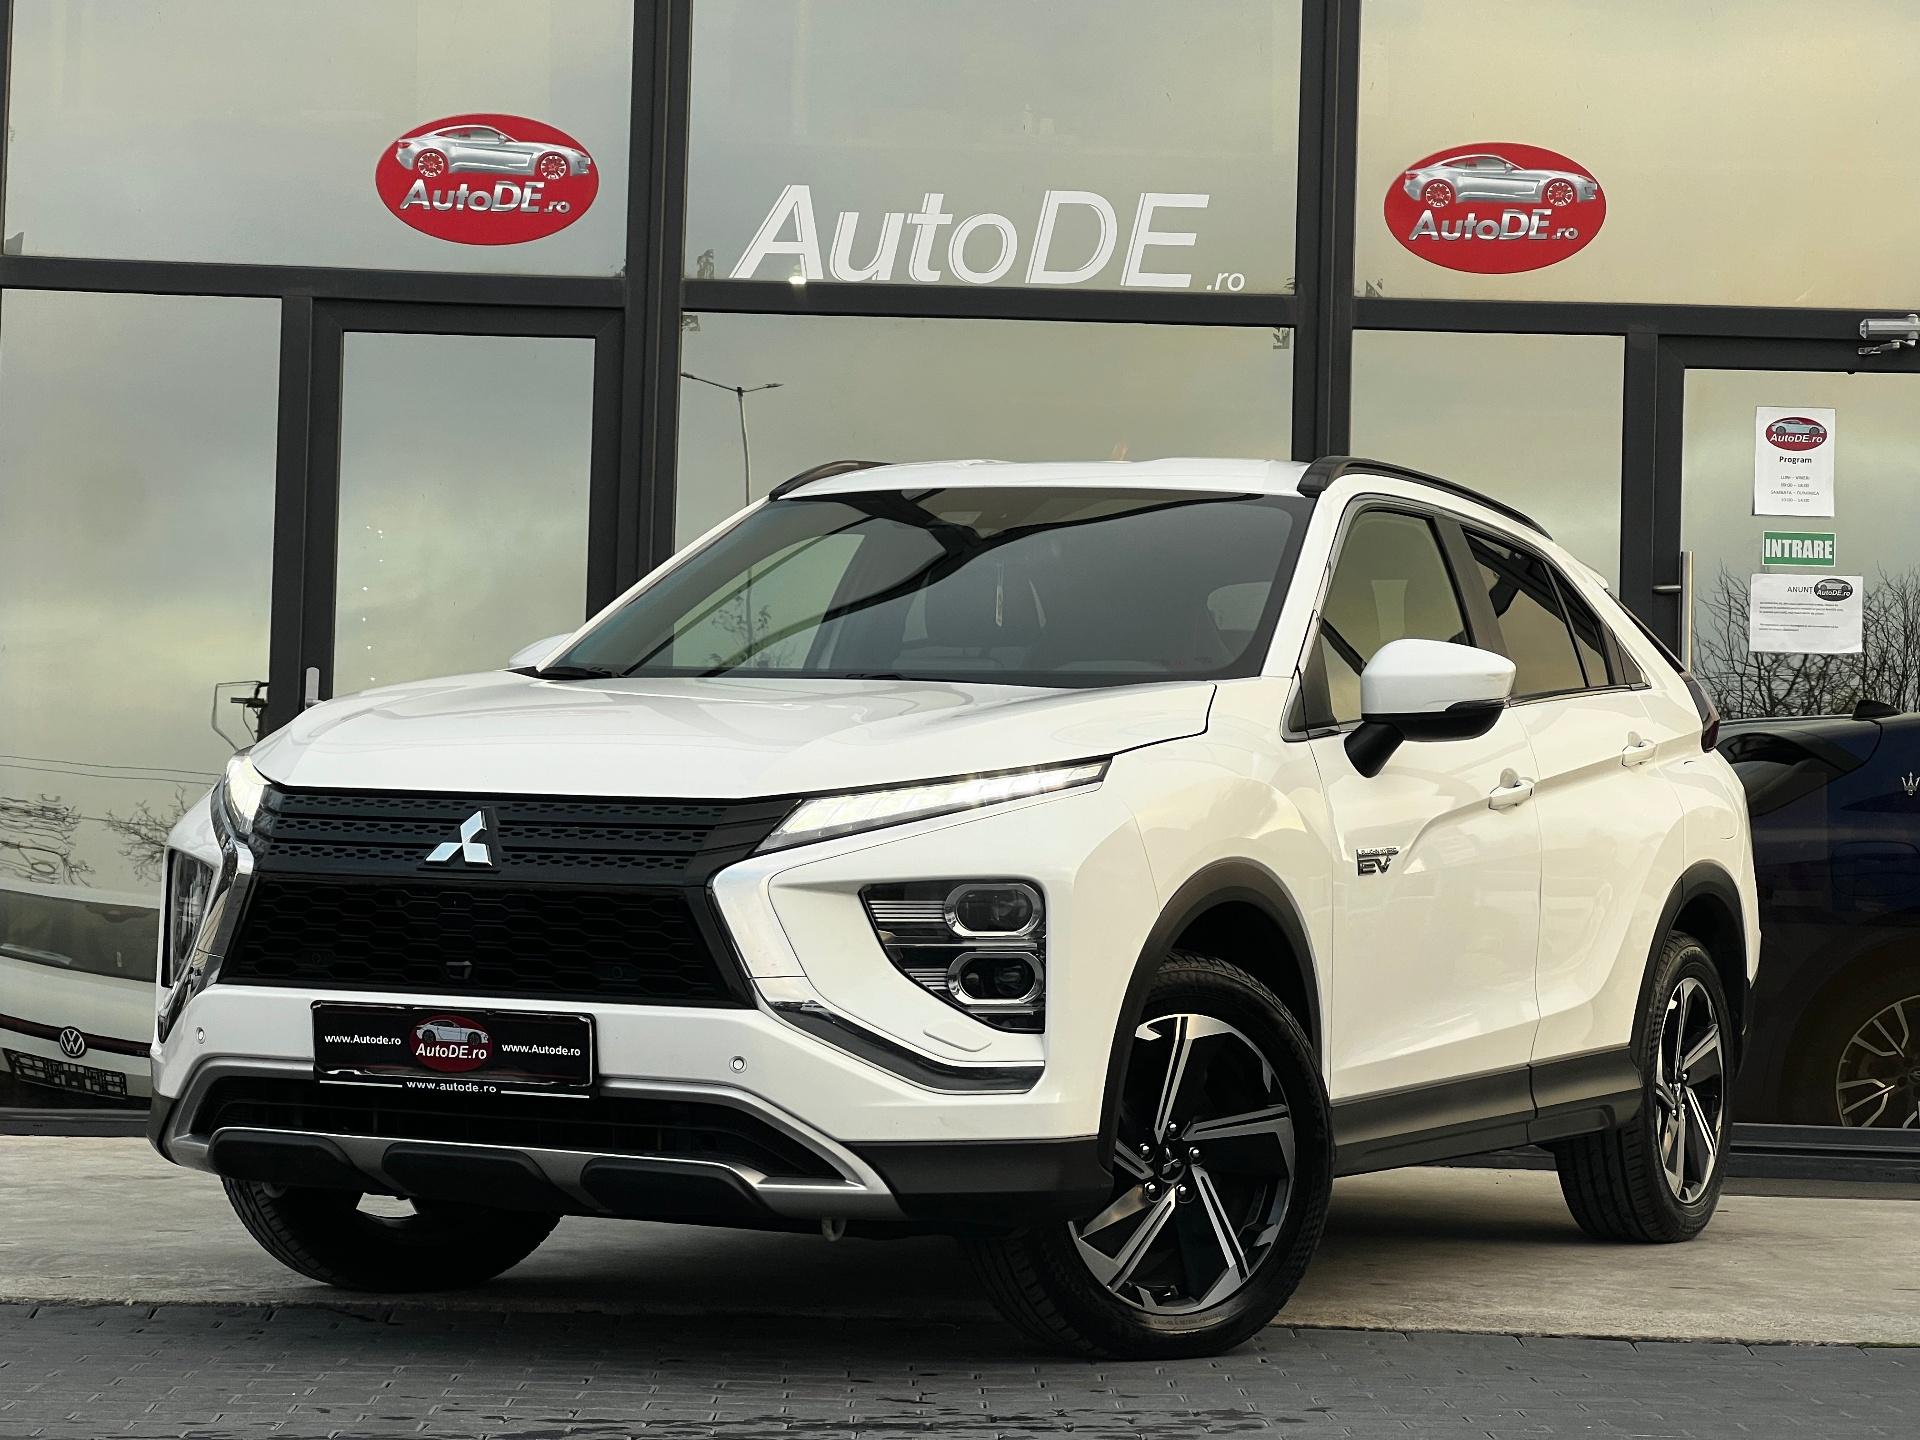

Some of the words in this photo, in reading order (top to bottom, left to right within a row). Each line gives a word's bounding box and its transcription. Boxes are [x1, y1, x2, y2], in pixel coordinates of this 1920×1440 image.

[1769, 433, 1823, 443] AutoDE.ro
[1779, 456, 1812, 465] Program
[1765, 538, 1833, 559] INTRARE
[324, 1033, 401, 1046] www.Autode.ro
[415, 1042, 488, 1060] AutoDE.ro
[501, 1043, 581, 1057] www.Autode.ro
[406, 1079, 497, 1093] www.autode.ro
